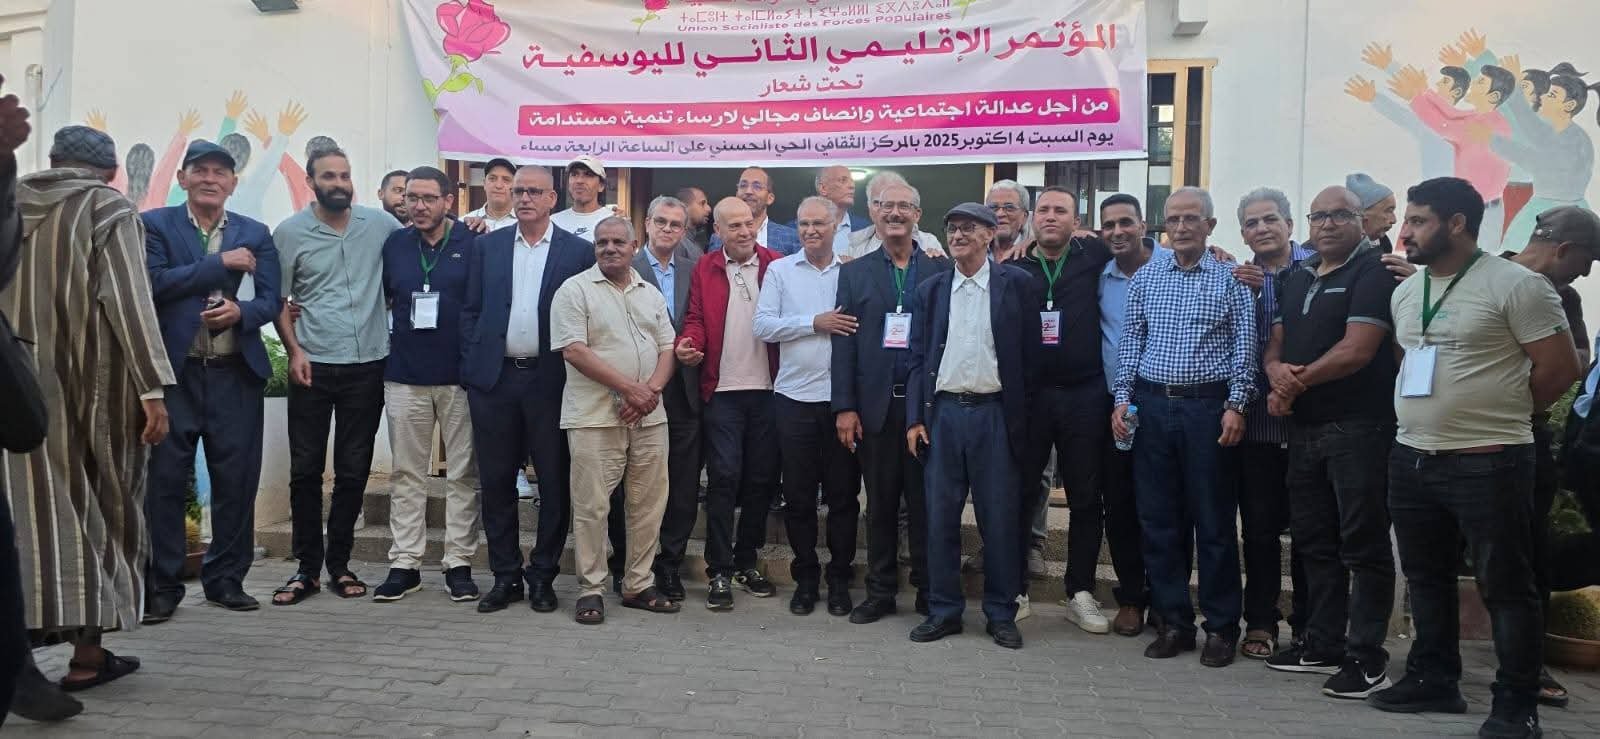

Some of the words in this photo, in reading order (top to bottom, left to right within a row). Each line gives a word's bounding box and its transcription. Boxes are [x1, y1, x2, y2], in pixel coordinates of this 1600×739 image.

[722, 22, 789, 31] Socialiste
[823, 17, 870, 26] Forces
[875, 12, 952, 24] Populaires
[826, 26, 990, 72] الإقليمي
[994, 22, 1117, 60] المؤتمر
[523, 41, 685, 76] لليوسفية
[694, 32, 817, 77] الثاني
[759, 76, 811, 97] شعار
[816, 73, 863, 92] تحت
[804, 105, 873, 124] وانصاف
[879, 100, 970, 121] اجتماعية
[976, 99, 1033, 116] عدالة
[1038, 93, 1077, 117] أجل
[1081, 97, 1109, 113] من
[529, 112, 617, 127] مستدامة
[621, 110, 673, 128] تنمية
[677, 109, 738, 126] لارساء
[741, 108, 800, 129] مجالي
[520, 140, 561, 153] مساء
[815, 136, 866, 156] الثقافي
[868, 135, 920, 154] بالمركز
[1016, 132, 1024, 145] 4
[1029, 129, 1084, 145] السبت
[1086, 130, 1114, 147] يوم
[564, 141, 615, 156] الرابعة
[618, 142, 675, 156] الساعة
[678, 143, 705, 155] على
[709, 139, 771, 158] الحسني
[775, 139, 812, 156] الحي
